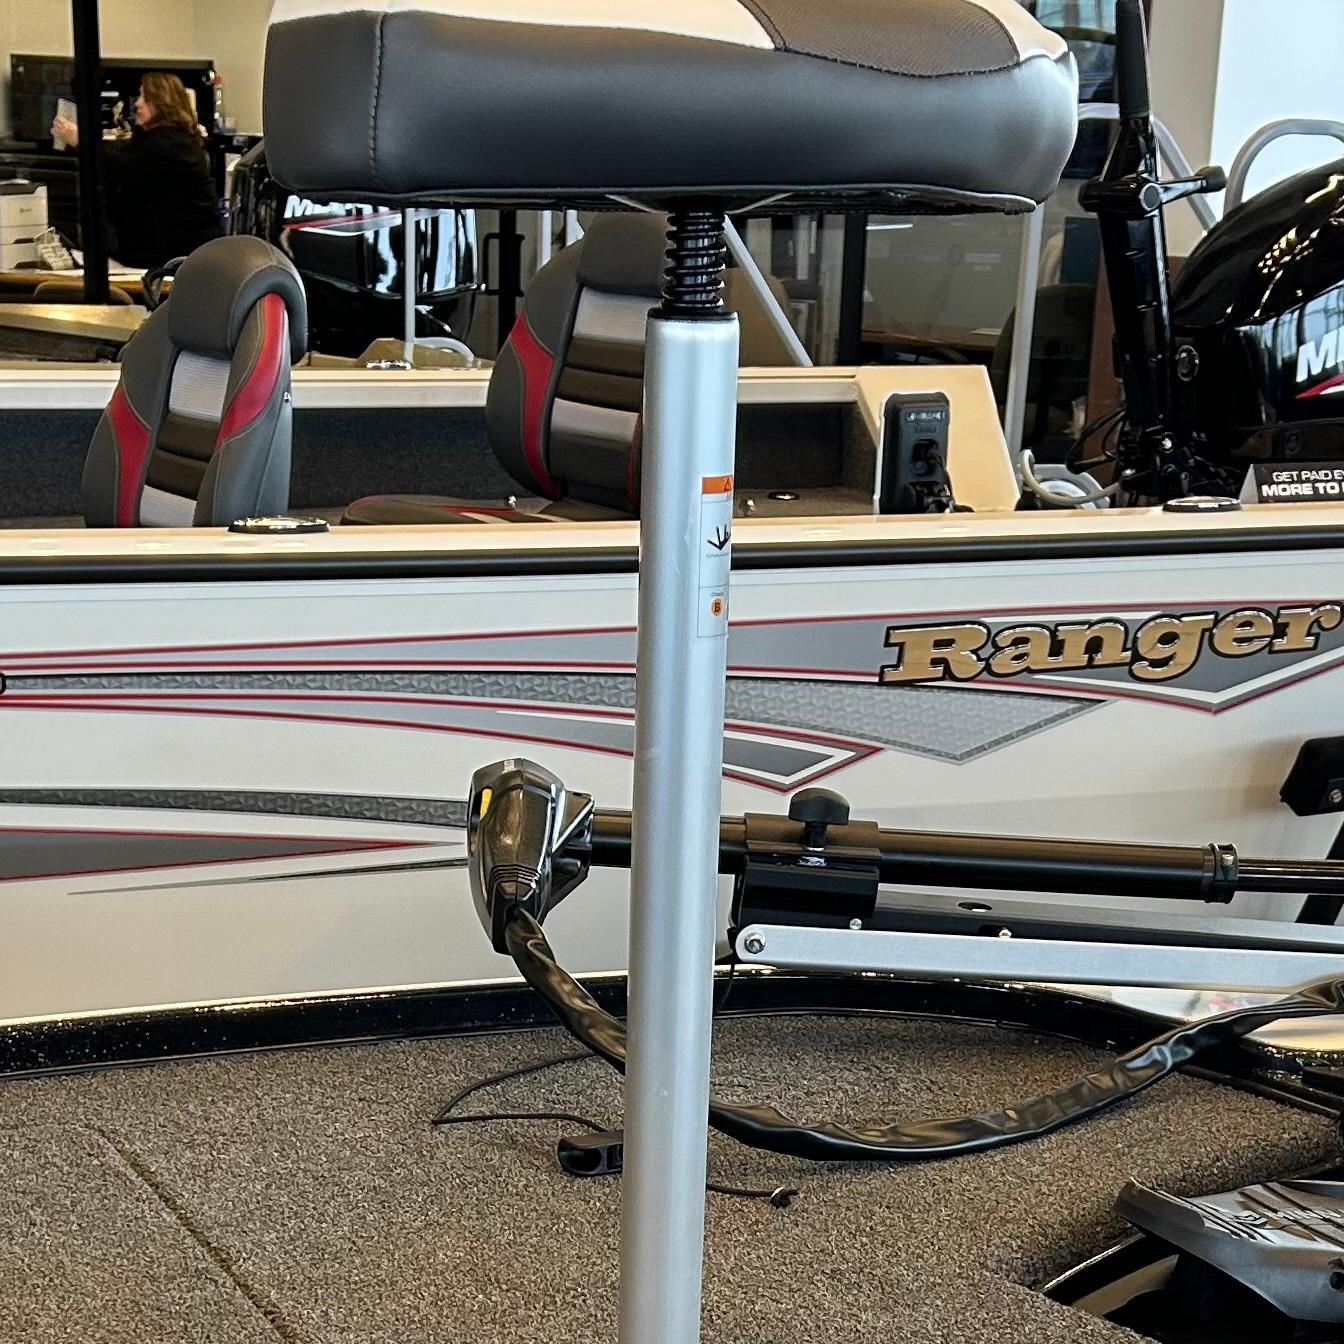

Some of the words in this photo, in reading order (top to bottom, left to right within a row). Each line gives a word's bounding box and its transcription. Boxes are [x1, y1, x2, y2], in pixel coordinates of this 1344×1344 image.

[1272, 470, 1299, 482] GET
[1300, 469, 1333, 481] PAID
[1261, 483, 1314, 497] MORE
[1314, 481, 1340, 494] TO
